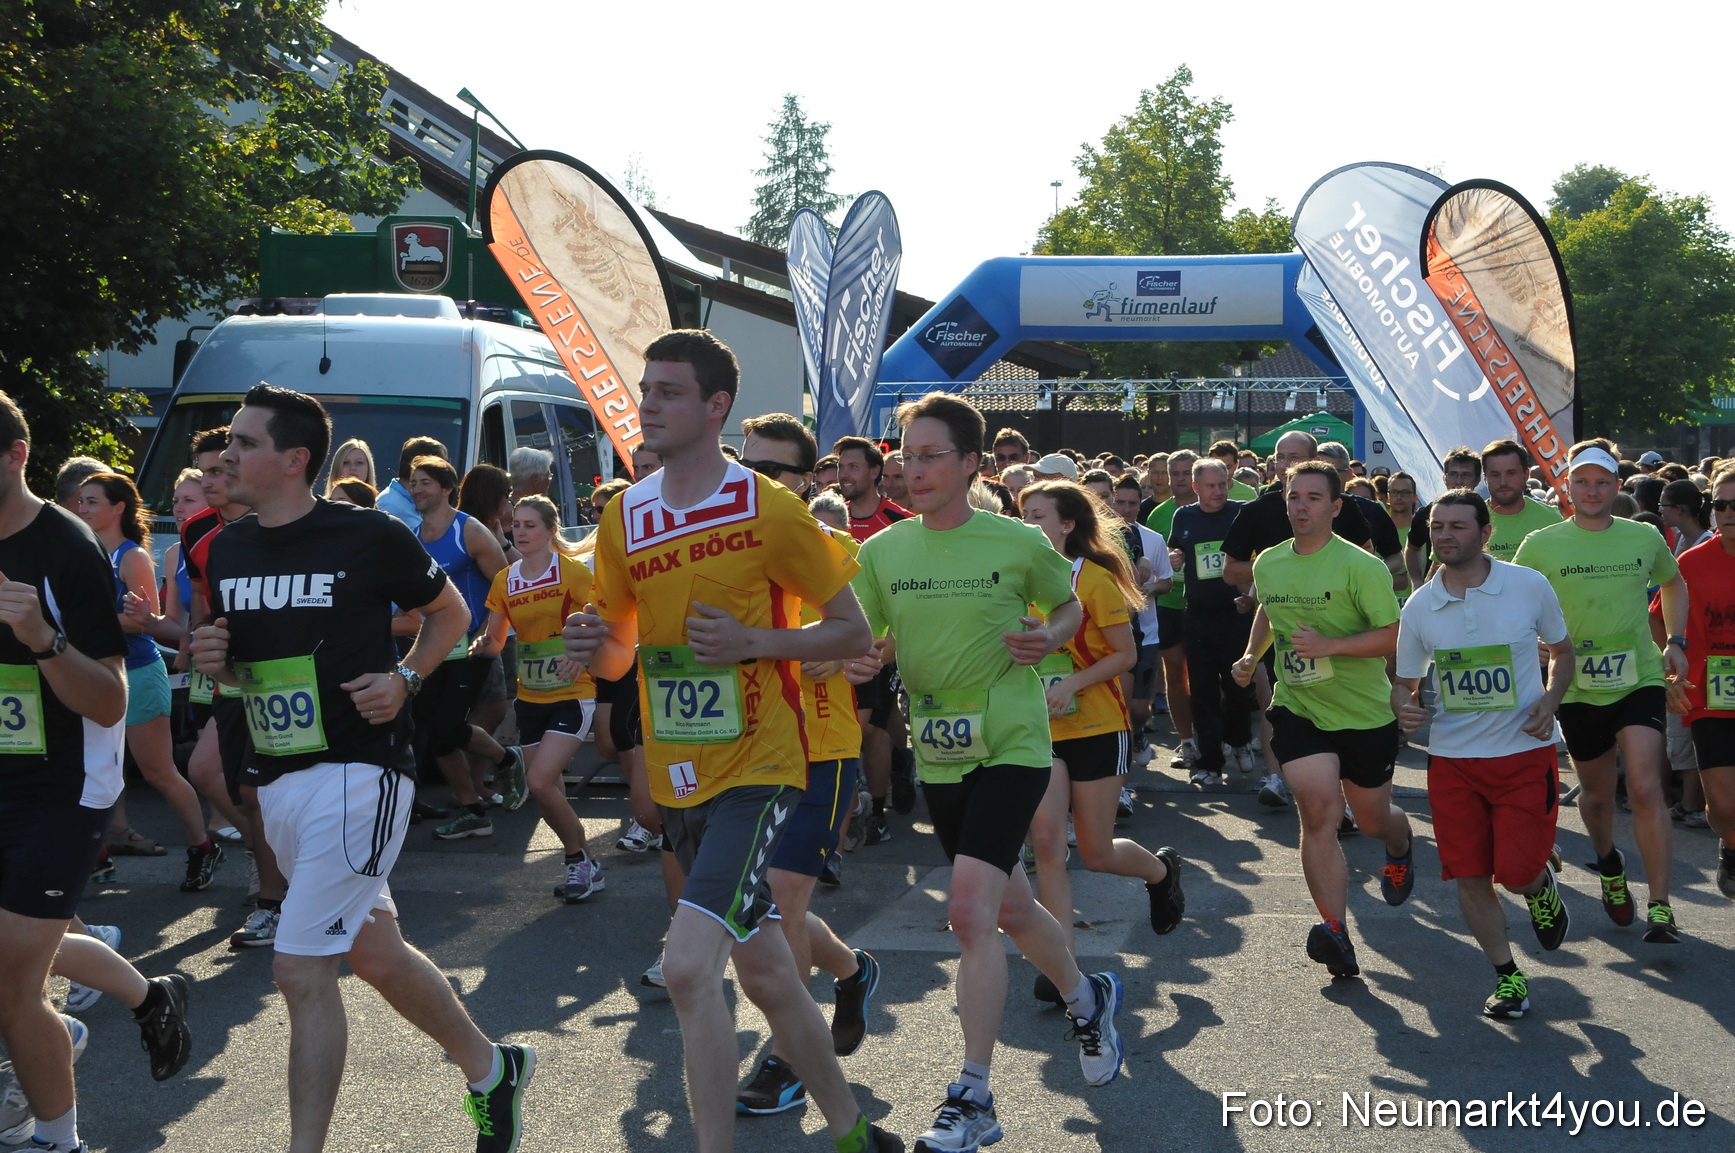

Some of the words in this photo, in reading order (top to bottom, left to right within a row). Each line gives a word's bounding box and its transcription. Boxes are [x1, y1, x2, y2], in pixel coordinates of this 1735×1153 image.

[409, 275, 435, 287] 1628
[1146, 279, 1179, 288] Fischer
[844, 226, 887, 381] Fischer
[1121, 296, 1219, 315] firmenlauf
[1120, 315, 1161, 323] neumarkt
[936, 329, 988, 344] Fischer
[629, 549, 683, 583] MAX
[690, 529, 763, 560] BÖGL
[1203, 554, 1225, 570] 13
[1560, 563, 1639, 577] globalconcepts
[219, 573, 335, 613] THULE
[890, 577, 994, 595] globalconcepts
[296, 597, 328, 605] SWEDEN
[508, 596, 531, 609] MAX
[530, 588, 564, 604] BÖGL
[523, 657, 558, 679] 774
[1582, 653, 1627, 678] 447
[1442, 667, 1511, 696] 1400
[657, 680, 725, 720] 792
[245, 690, 315, 732] 1399
[920, 718, 972, 750] 439
